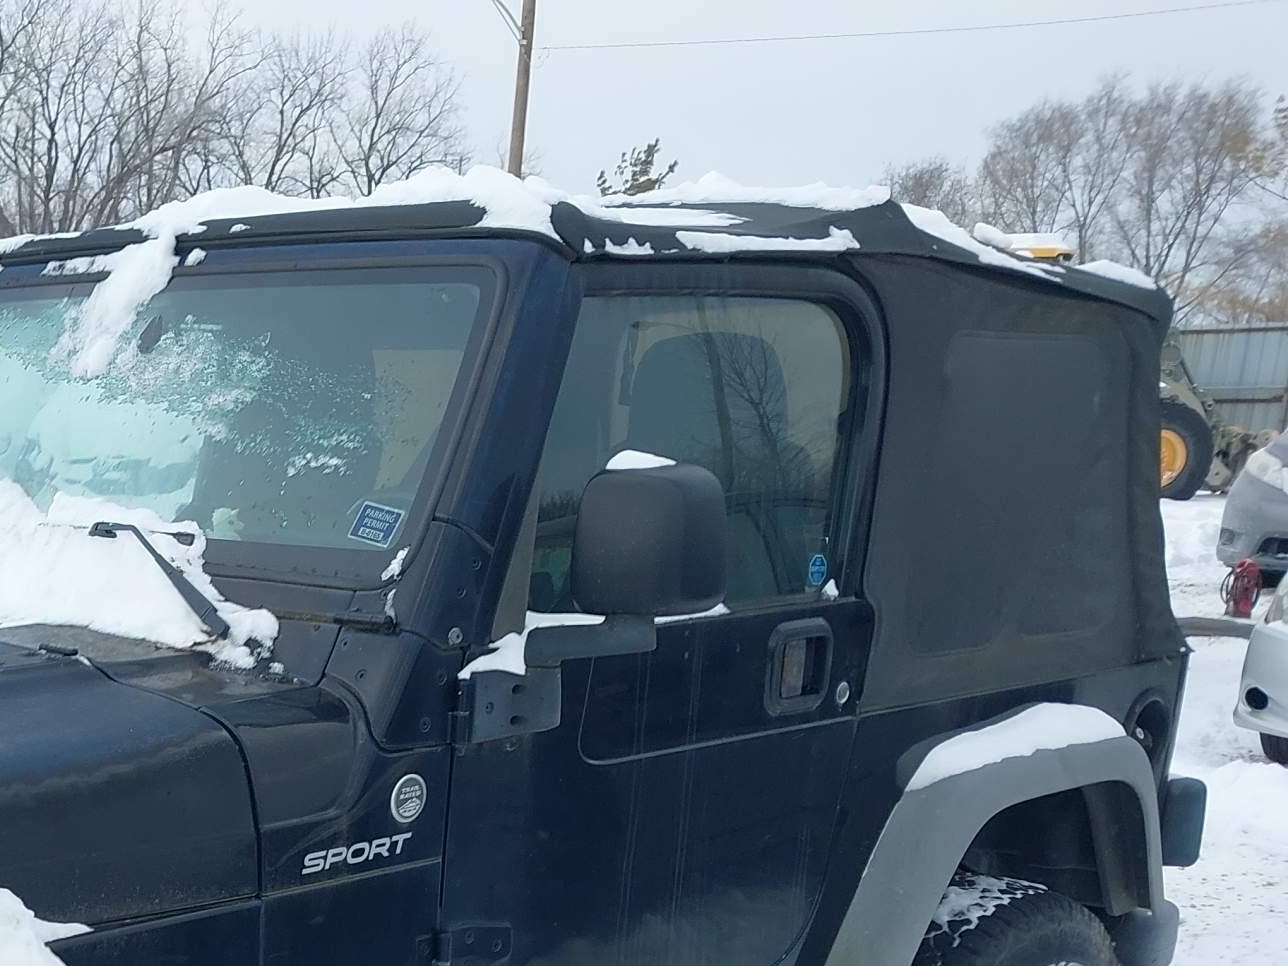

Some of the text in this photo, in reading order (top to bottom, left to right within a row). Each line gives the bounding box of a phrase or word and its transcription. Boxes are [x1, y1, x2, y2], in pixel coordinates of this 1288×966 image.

[365, 508, 397, 523] PARKING
[362, 517, 390, 531] PERMIT
[301, 832, 412, 876] SPORT
